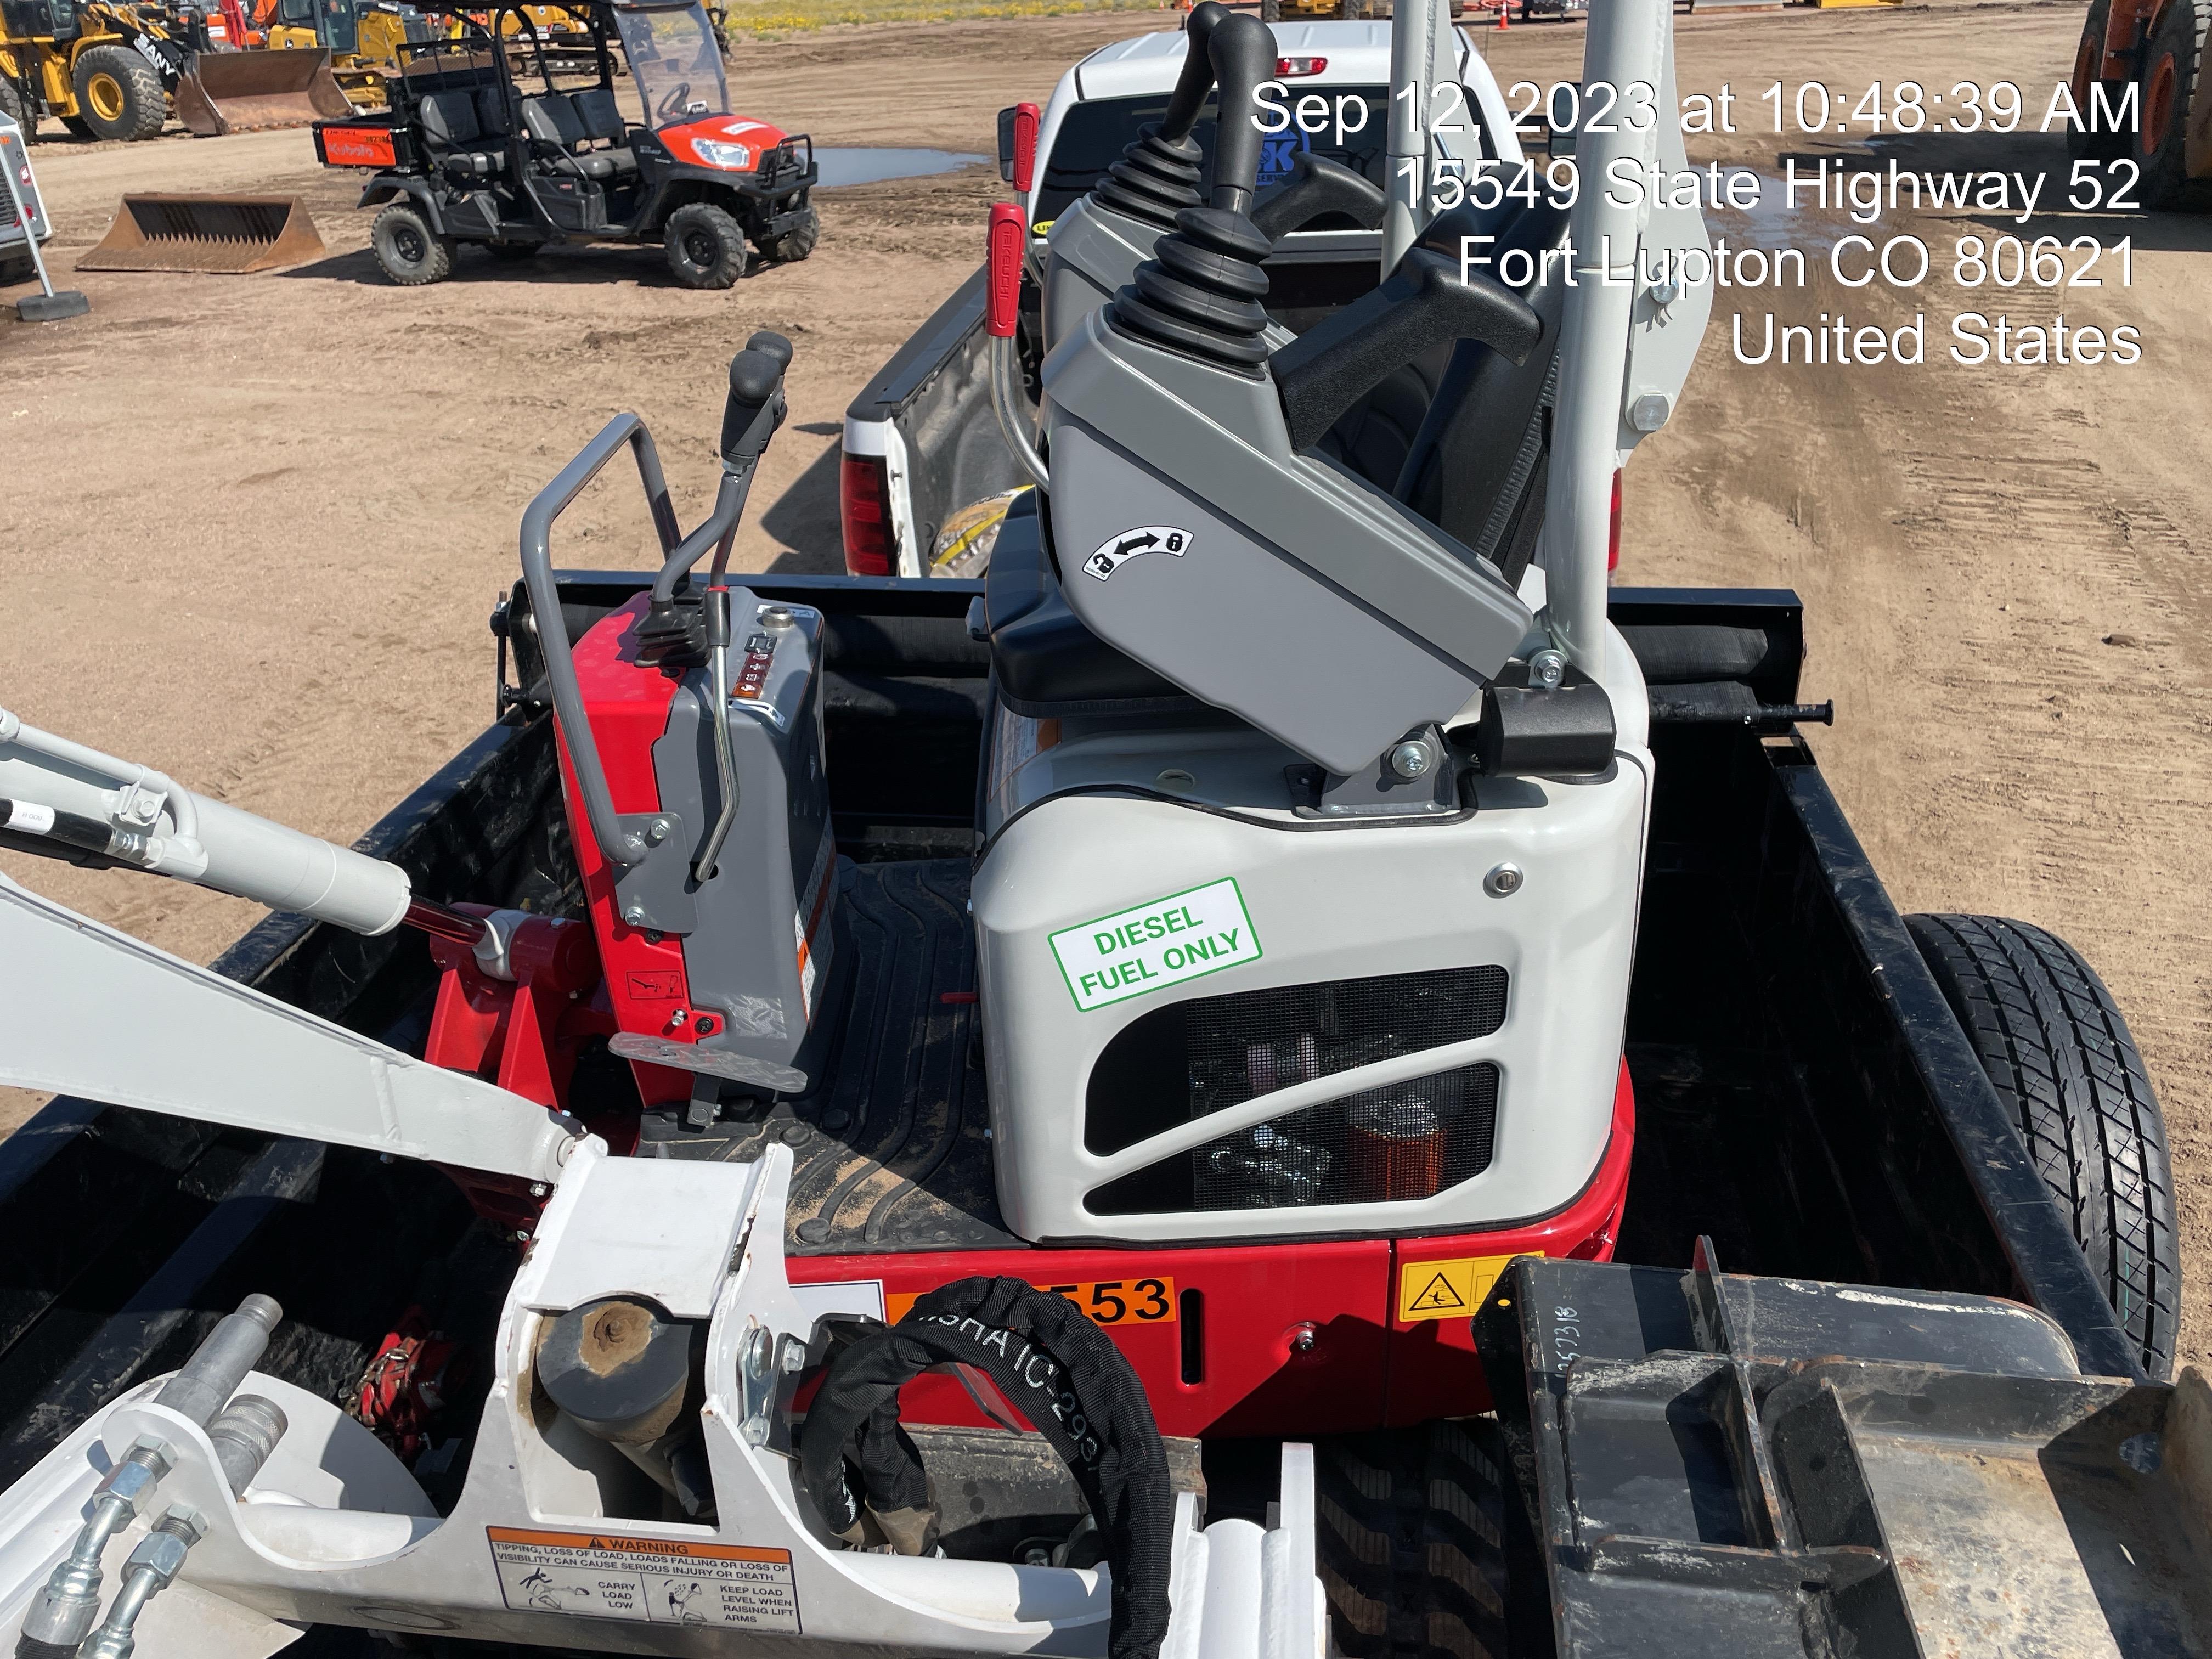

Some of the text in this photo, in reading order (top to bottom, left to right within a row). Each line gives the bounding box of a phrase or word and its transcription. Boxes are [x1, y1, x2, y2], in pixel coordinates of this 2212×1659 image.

[1000, 227, 1013, 300] TAKEUCHI
[1093, 906, 1203, 955] DIESEL
[1079, 927, 1240, 997] FUEL ONLY
[608, 1539, 688, 1554] WARNING
[495, 1543, 541, 1554] TIPPING,
[543, 1547, 573, 1556] LOSS
[594, 1551, 628, 1561] LOAD,
[630, 1553, 668, 1563] LOADS
[671, 1556, 718, 1567] FALLING
[720, 1561, 737, 1569] OR
[741, 1562, 770, 1571] LOSS
[773, 1564, 788, 1572] OF
[496, 1552, 774, 1581] VISIBILITY CAN CAUSE SERIOUS INJURY OR DEATH
[598, 1581, 635, 1590] CARRY
[720, 1585, 783, 1596] KEEP LOAD
[602, 1591, 632, 1600] LOAD
[722, 1595, 792, 1606] LEVEL WHEN
[608, 1601, 633, 1609] LOW
[723, 1604, 794, 1616] RAISING LIFT
[725, 1614, 757, 1623] ARMS
